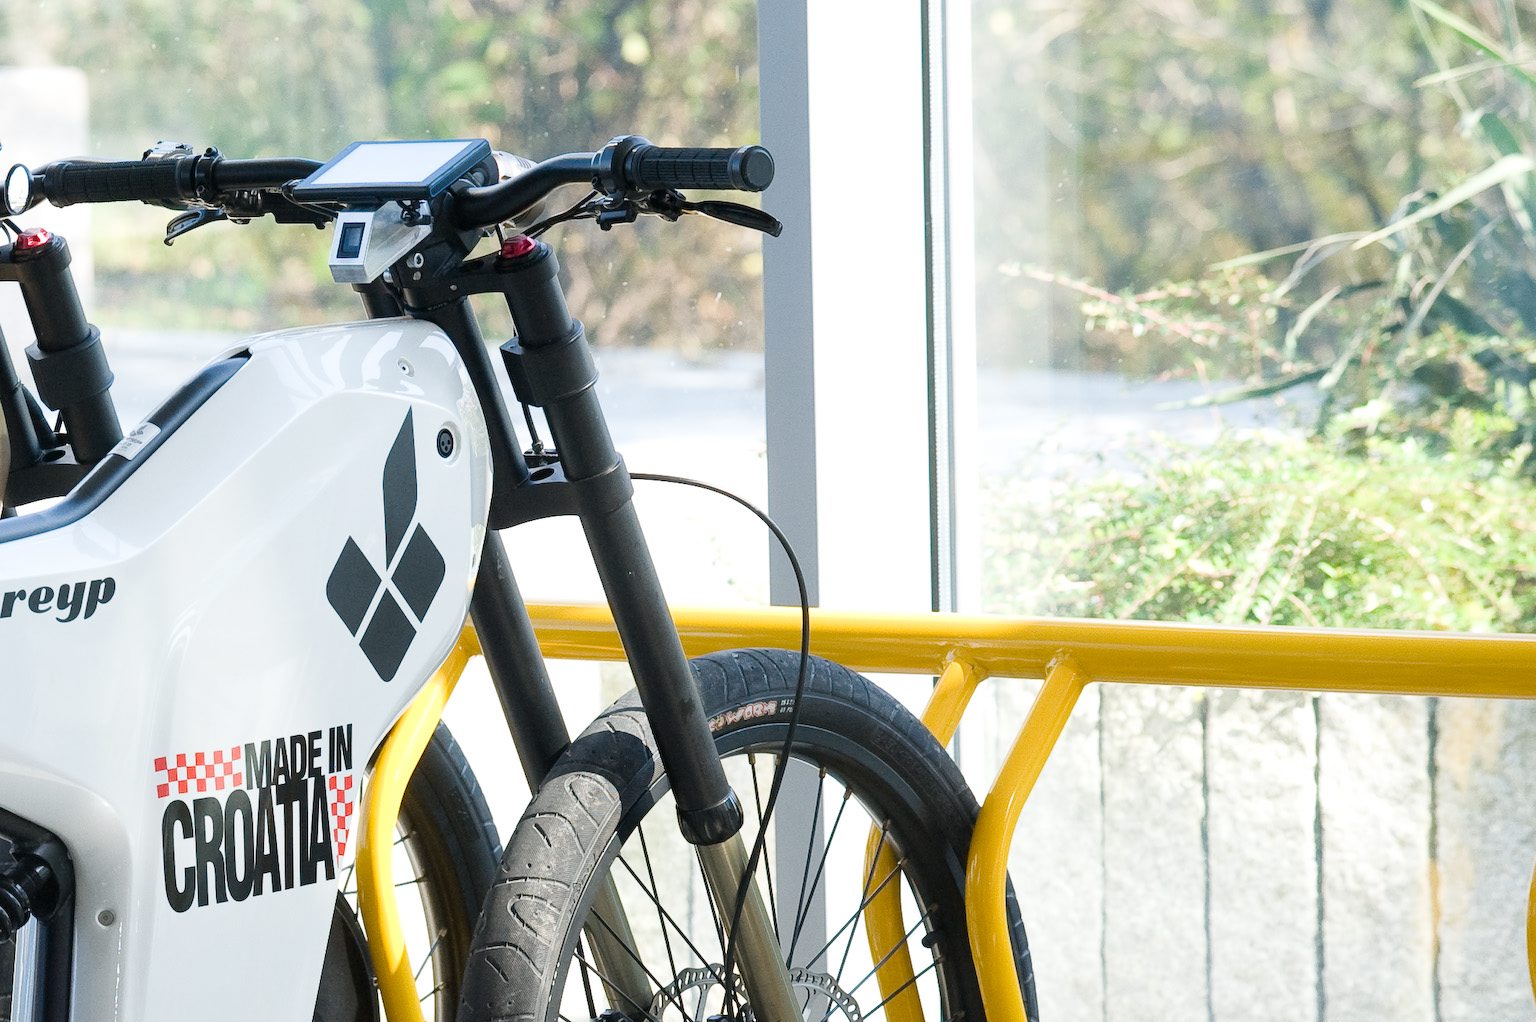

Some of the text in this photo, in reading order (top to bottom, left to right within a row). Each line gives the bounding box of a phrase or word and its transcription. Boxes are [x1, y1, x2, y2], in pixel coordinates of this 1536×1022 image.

[244, 723, 353, 790] MADE IN
[161, 773, 335, 913] CROATIA
